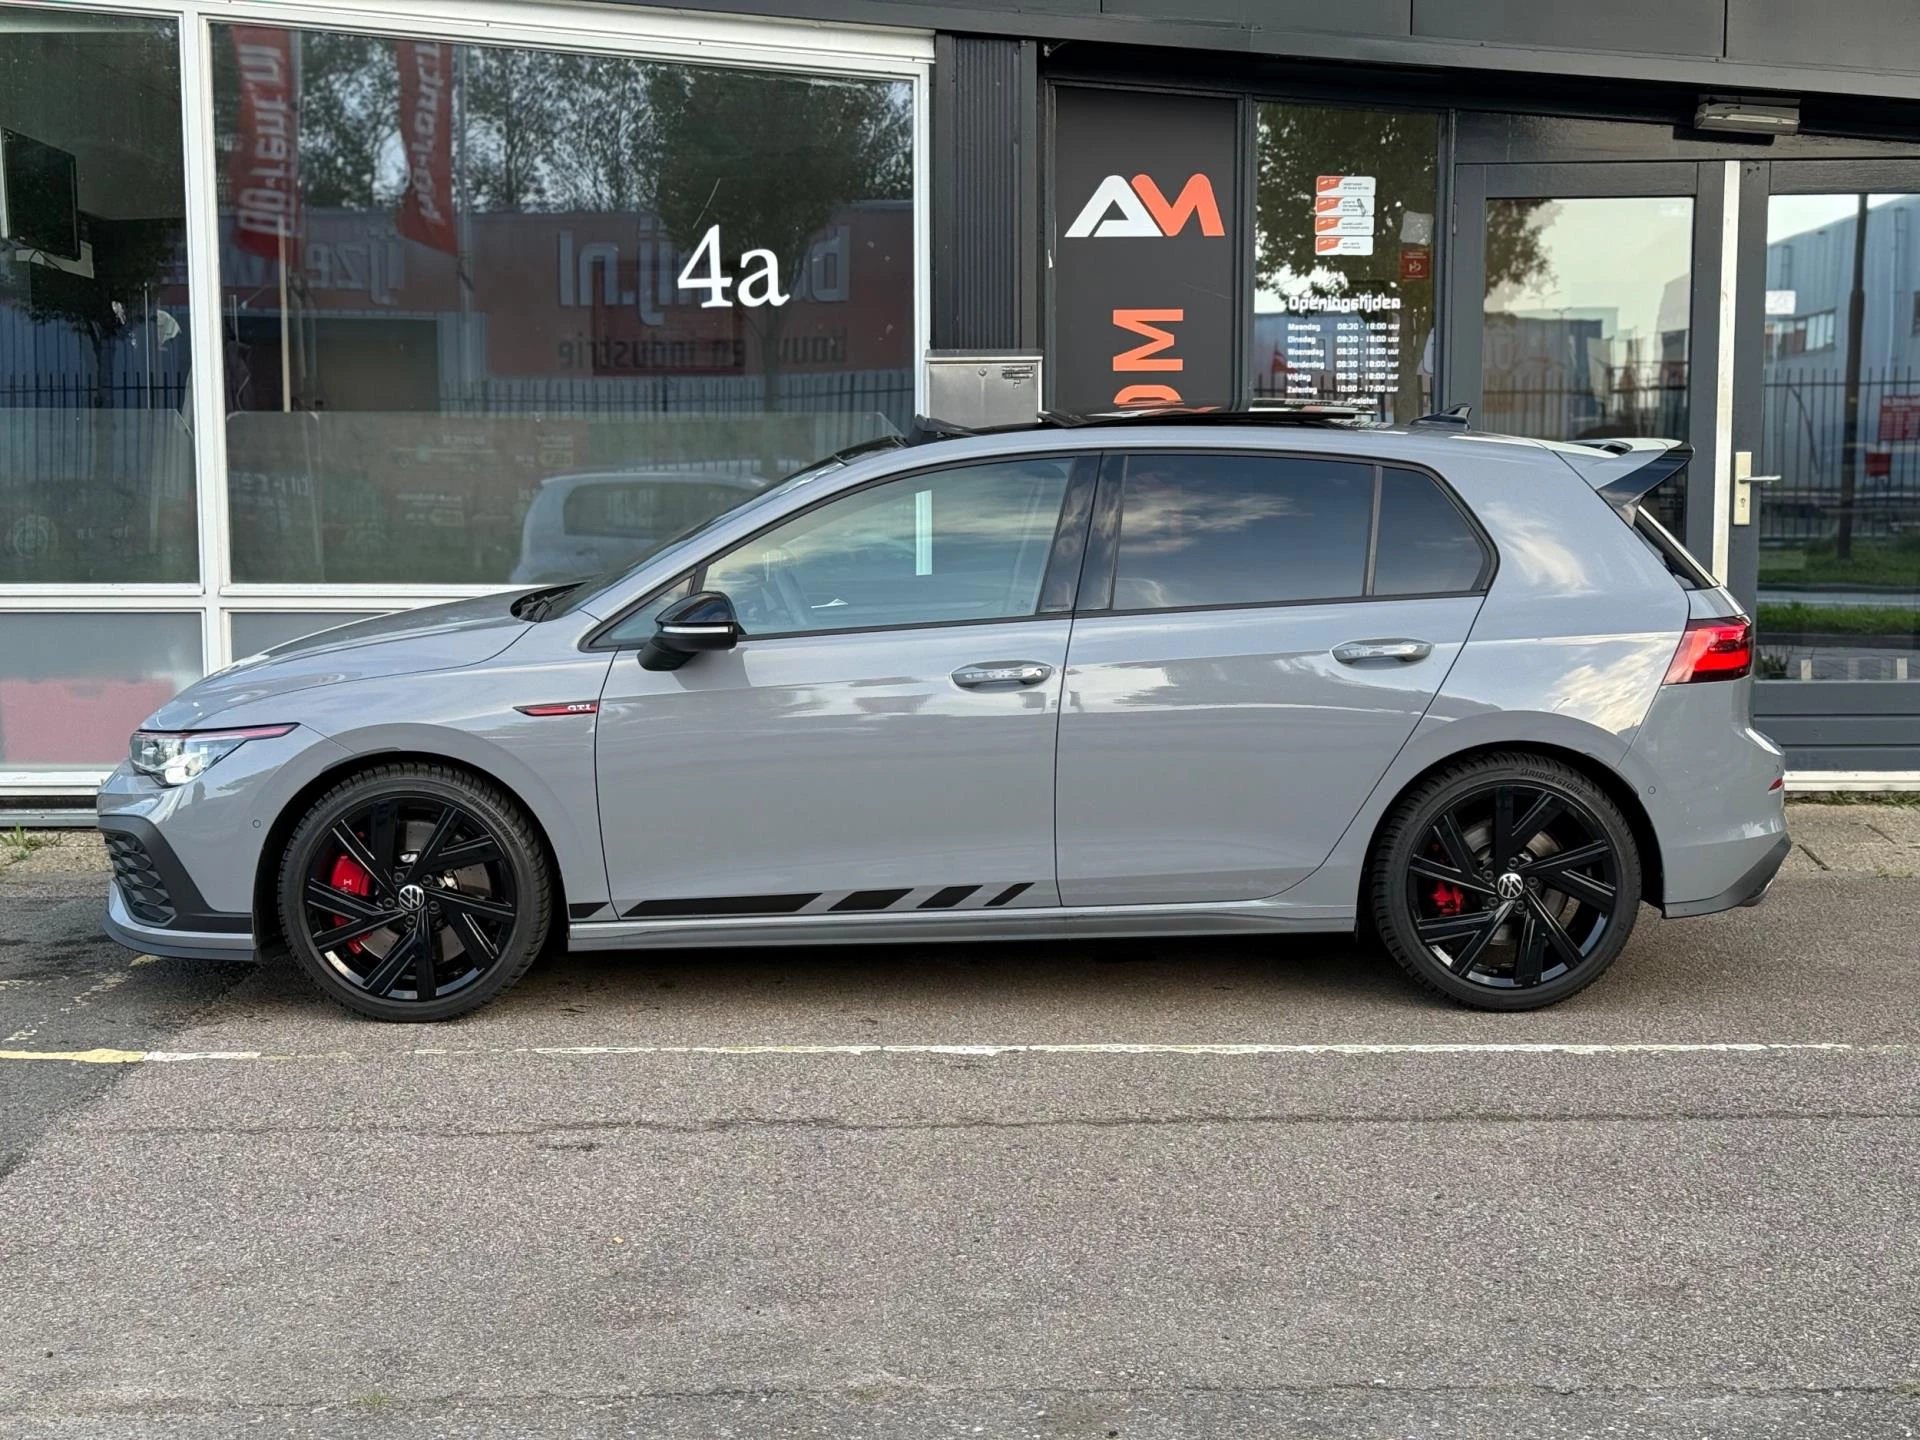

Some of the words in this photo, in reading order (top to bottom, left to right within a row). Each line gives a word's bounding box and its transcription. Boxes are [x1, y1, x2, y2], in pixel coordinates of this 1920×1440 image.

[1064, 173, 1226, 238] AM
[677, 224, 791, 309] 4a
[1287, 294, 1401, 313] Openingstijden
[1287, 323, 1321, 332] Maandag
[1287, 336, 1316, 344] Dinsdag
[1112, 309, 1184, 405] M
[1287, 348, 1325, 357] Woensdag
[1287, 360, 1325, 370] Donderdag
[1287, 373, 1312, 382] Vrijdag
[1287, 386, 1318, 395] Zaterdag
[567, 704, 592, 712] GTI
[1520, 767, 1586, 796] BRIDGESTONE
